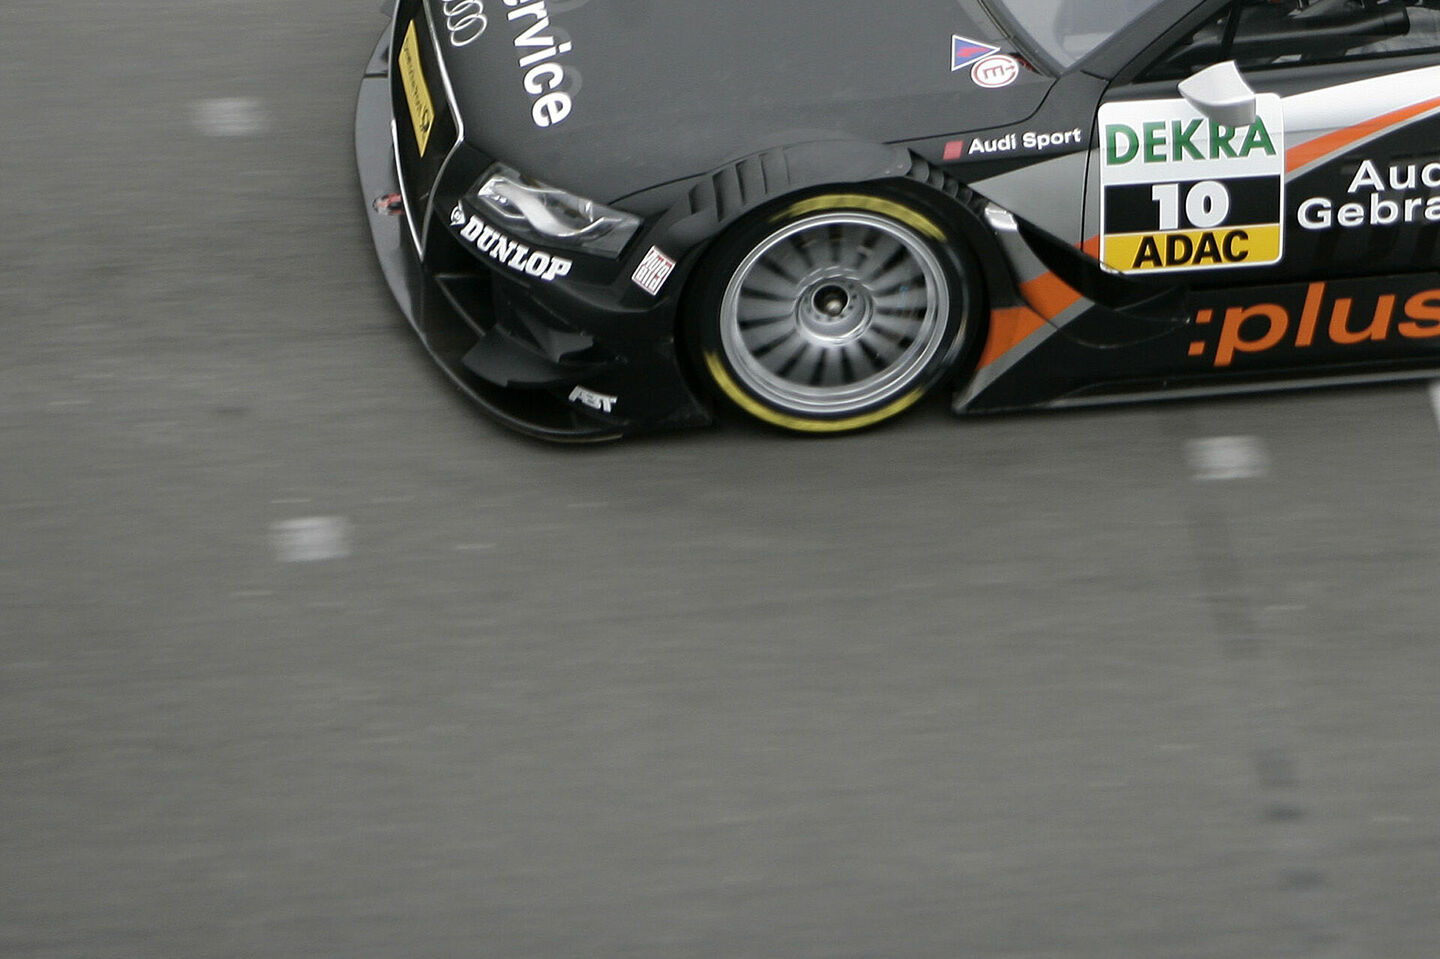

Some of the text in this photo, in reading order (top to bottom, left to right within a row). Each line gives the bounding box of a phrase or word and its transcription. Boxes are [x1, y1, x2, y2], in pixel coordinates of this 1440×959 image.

[968, 127, 1082, 155] Audi Sport
[1105, 115, 1277, 166] DEKRA
[1152, 180, 1230, 231] 10
[460, 214, 573, 282] DUNLOP
[1132, 229, 1249, 269] ADAC
